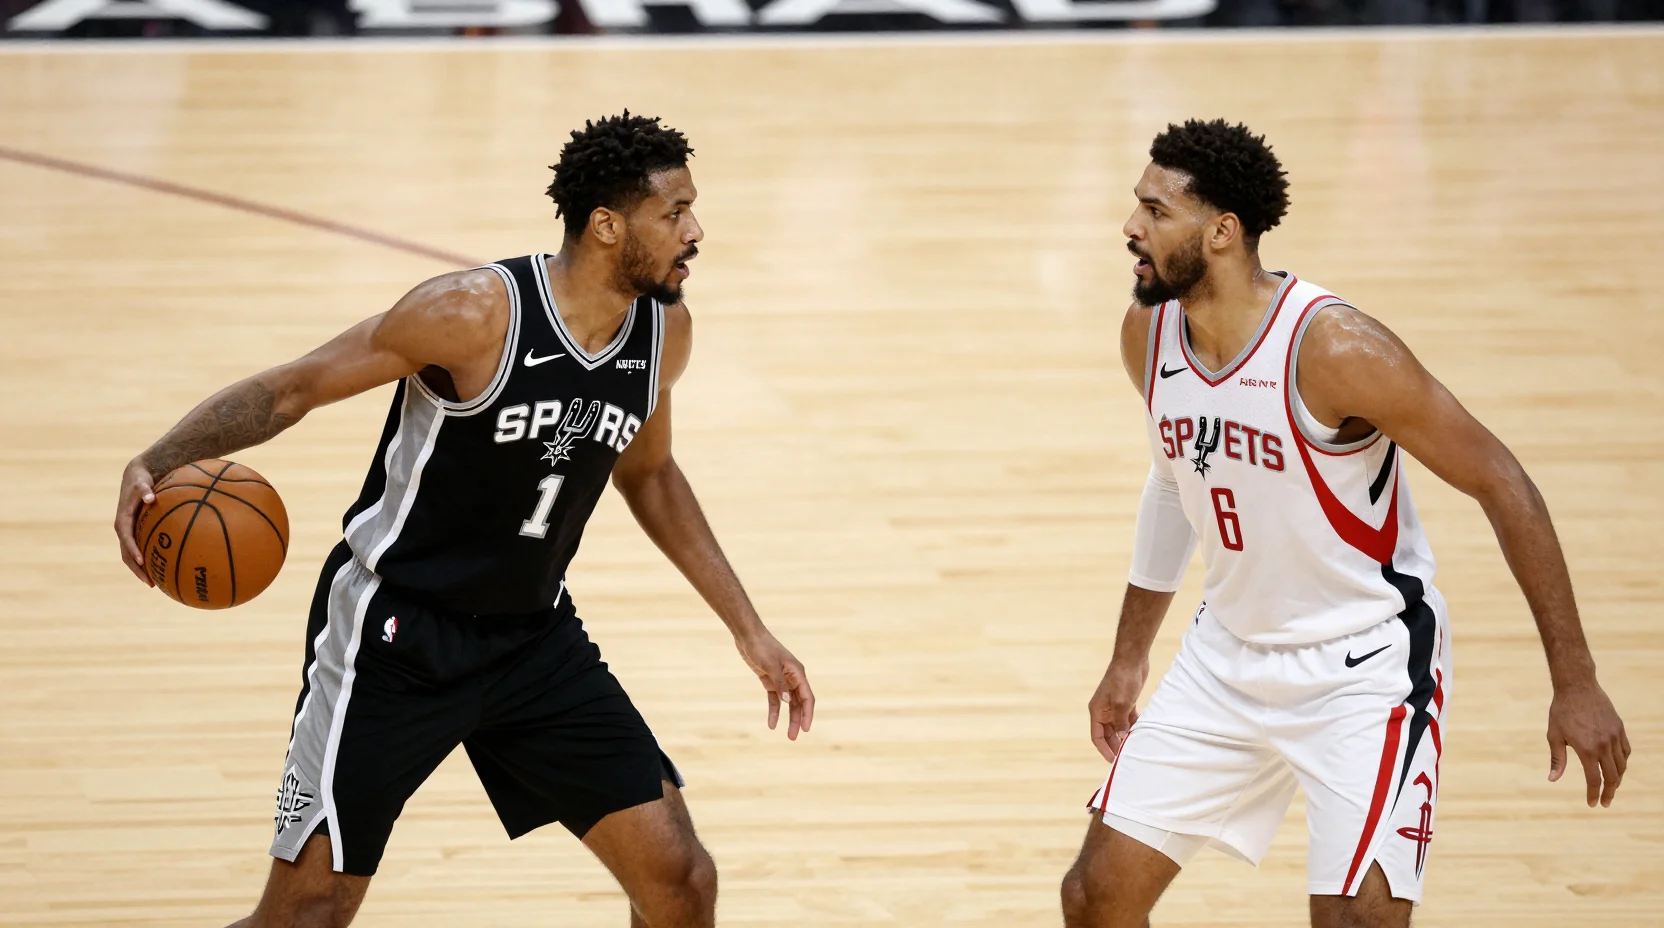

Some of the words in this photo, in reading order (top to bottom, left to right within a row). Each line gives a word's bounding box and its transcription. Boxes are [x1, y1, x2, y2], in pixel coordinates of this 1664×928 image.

[494, 398, 643, 467] SPURS
[518, 473, 565, 540] 1
[1210, 487, 1244, 552] 6
